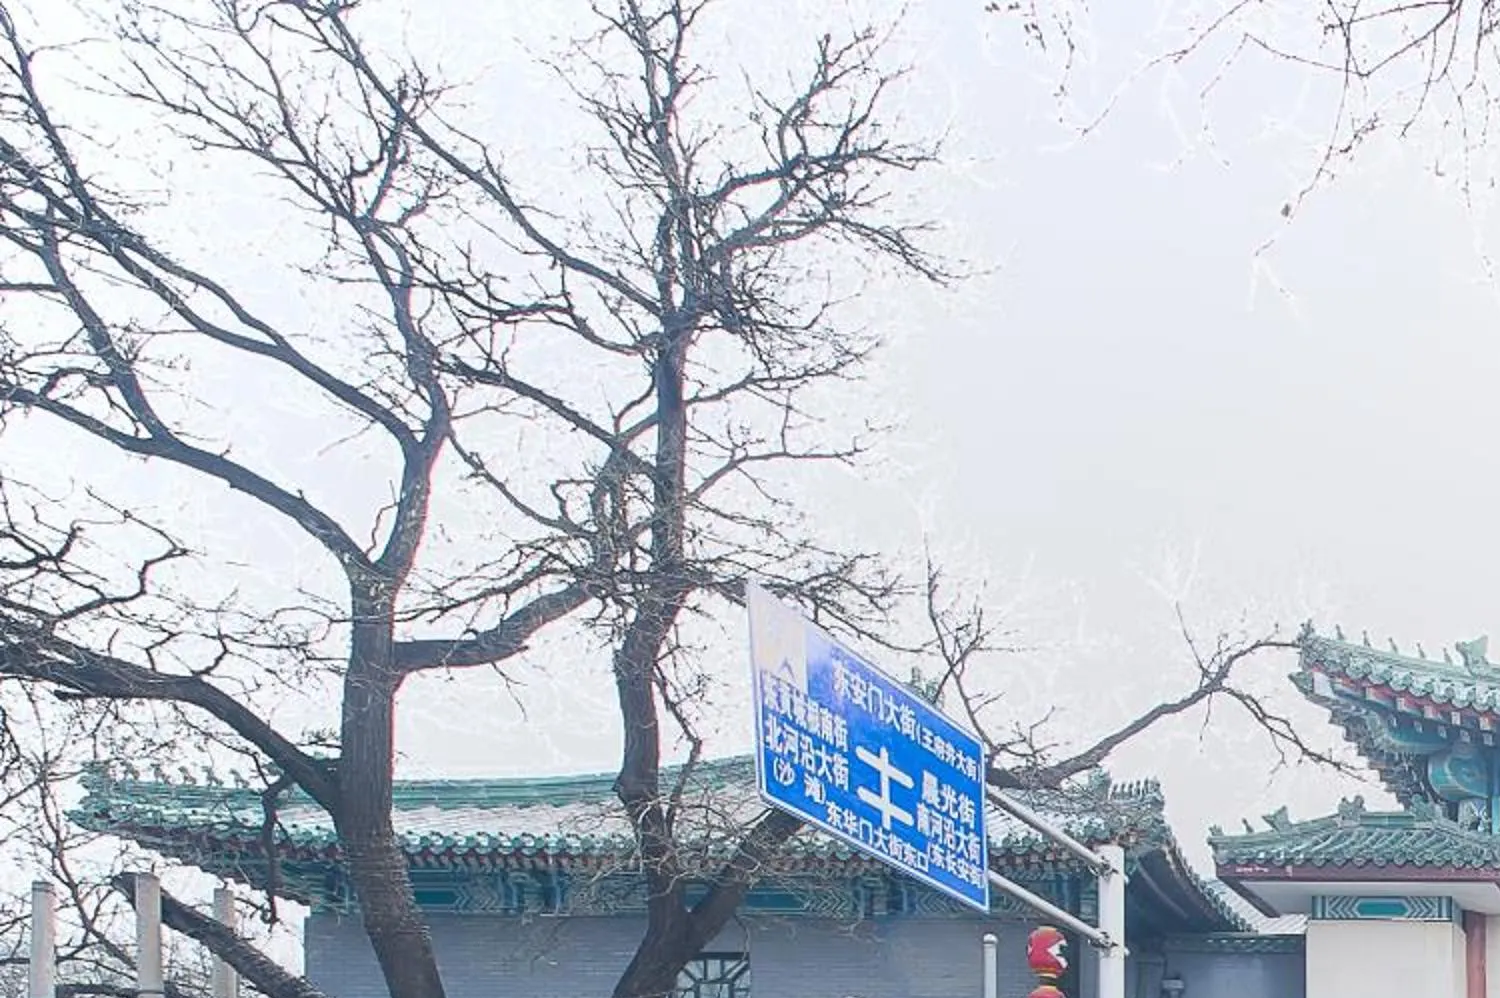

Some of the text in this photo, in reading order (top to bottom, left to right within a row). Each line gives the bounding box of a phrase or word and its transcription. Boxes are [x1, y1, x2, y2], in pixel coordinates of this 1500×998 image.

[765, 713, 850, 790] 北河沿大街
[826, 801, 929, 872] 东华门大街东口
[916, 802, 981, 865] 南河沿大街
